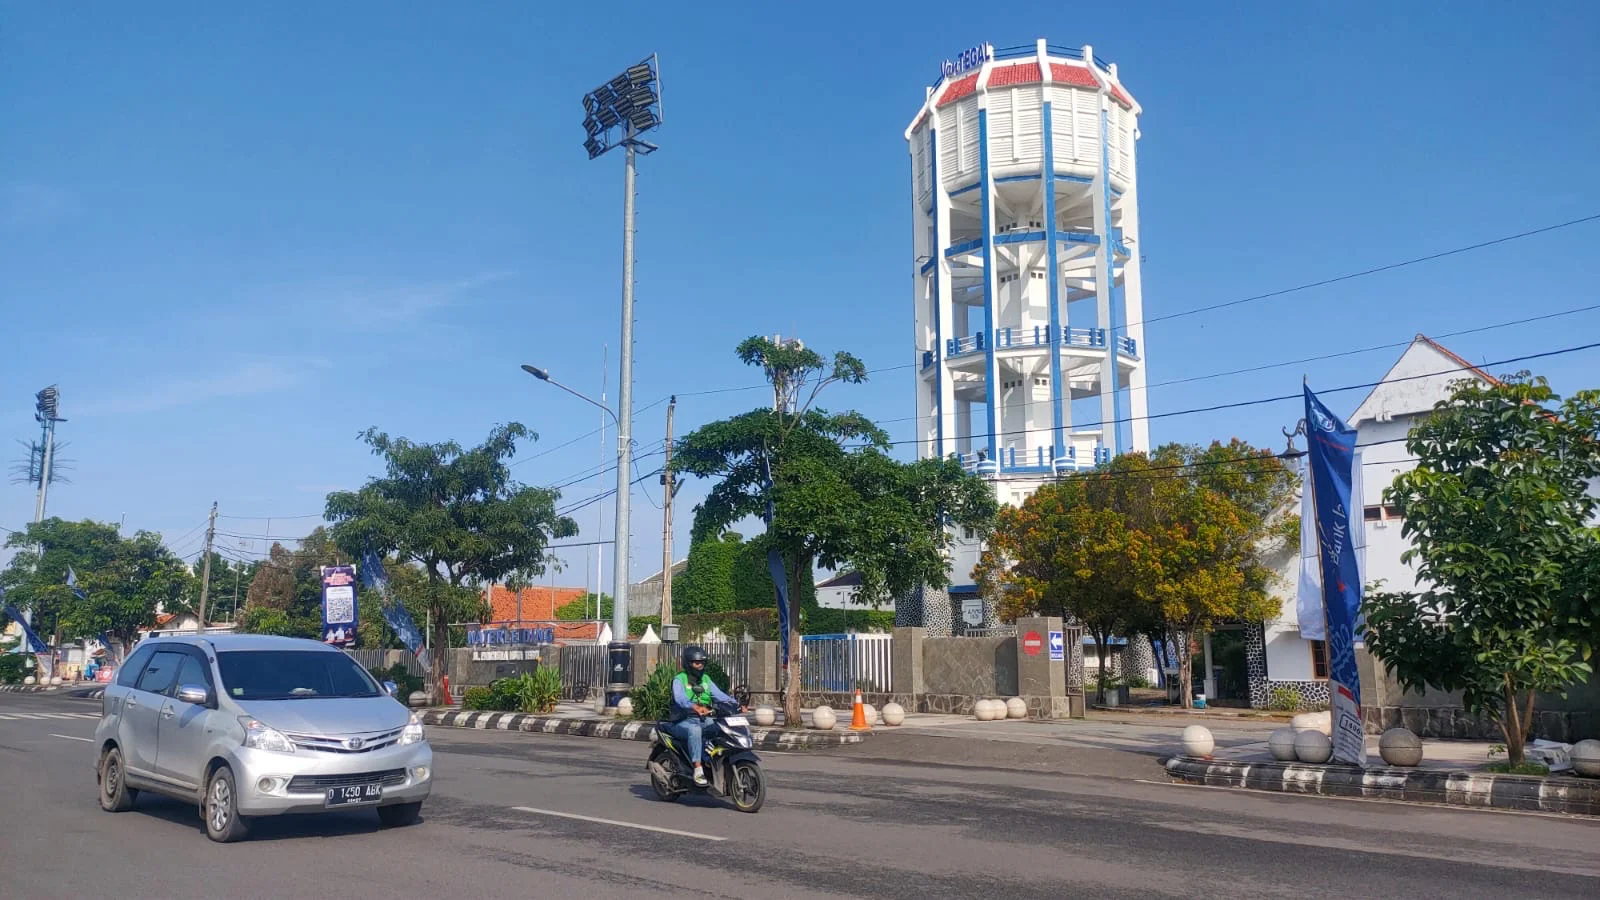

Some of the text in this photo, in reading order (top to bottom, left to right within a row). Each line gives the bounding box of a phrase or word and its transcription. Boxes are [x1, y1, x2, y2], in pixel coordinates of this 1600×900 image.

[958, 41, 990, 72] TEGAL
[1332, 521, 1346, 565] Bank
[341, 786, 360, 798] 1450
